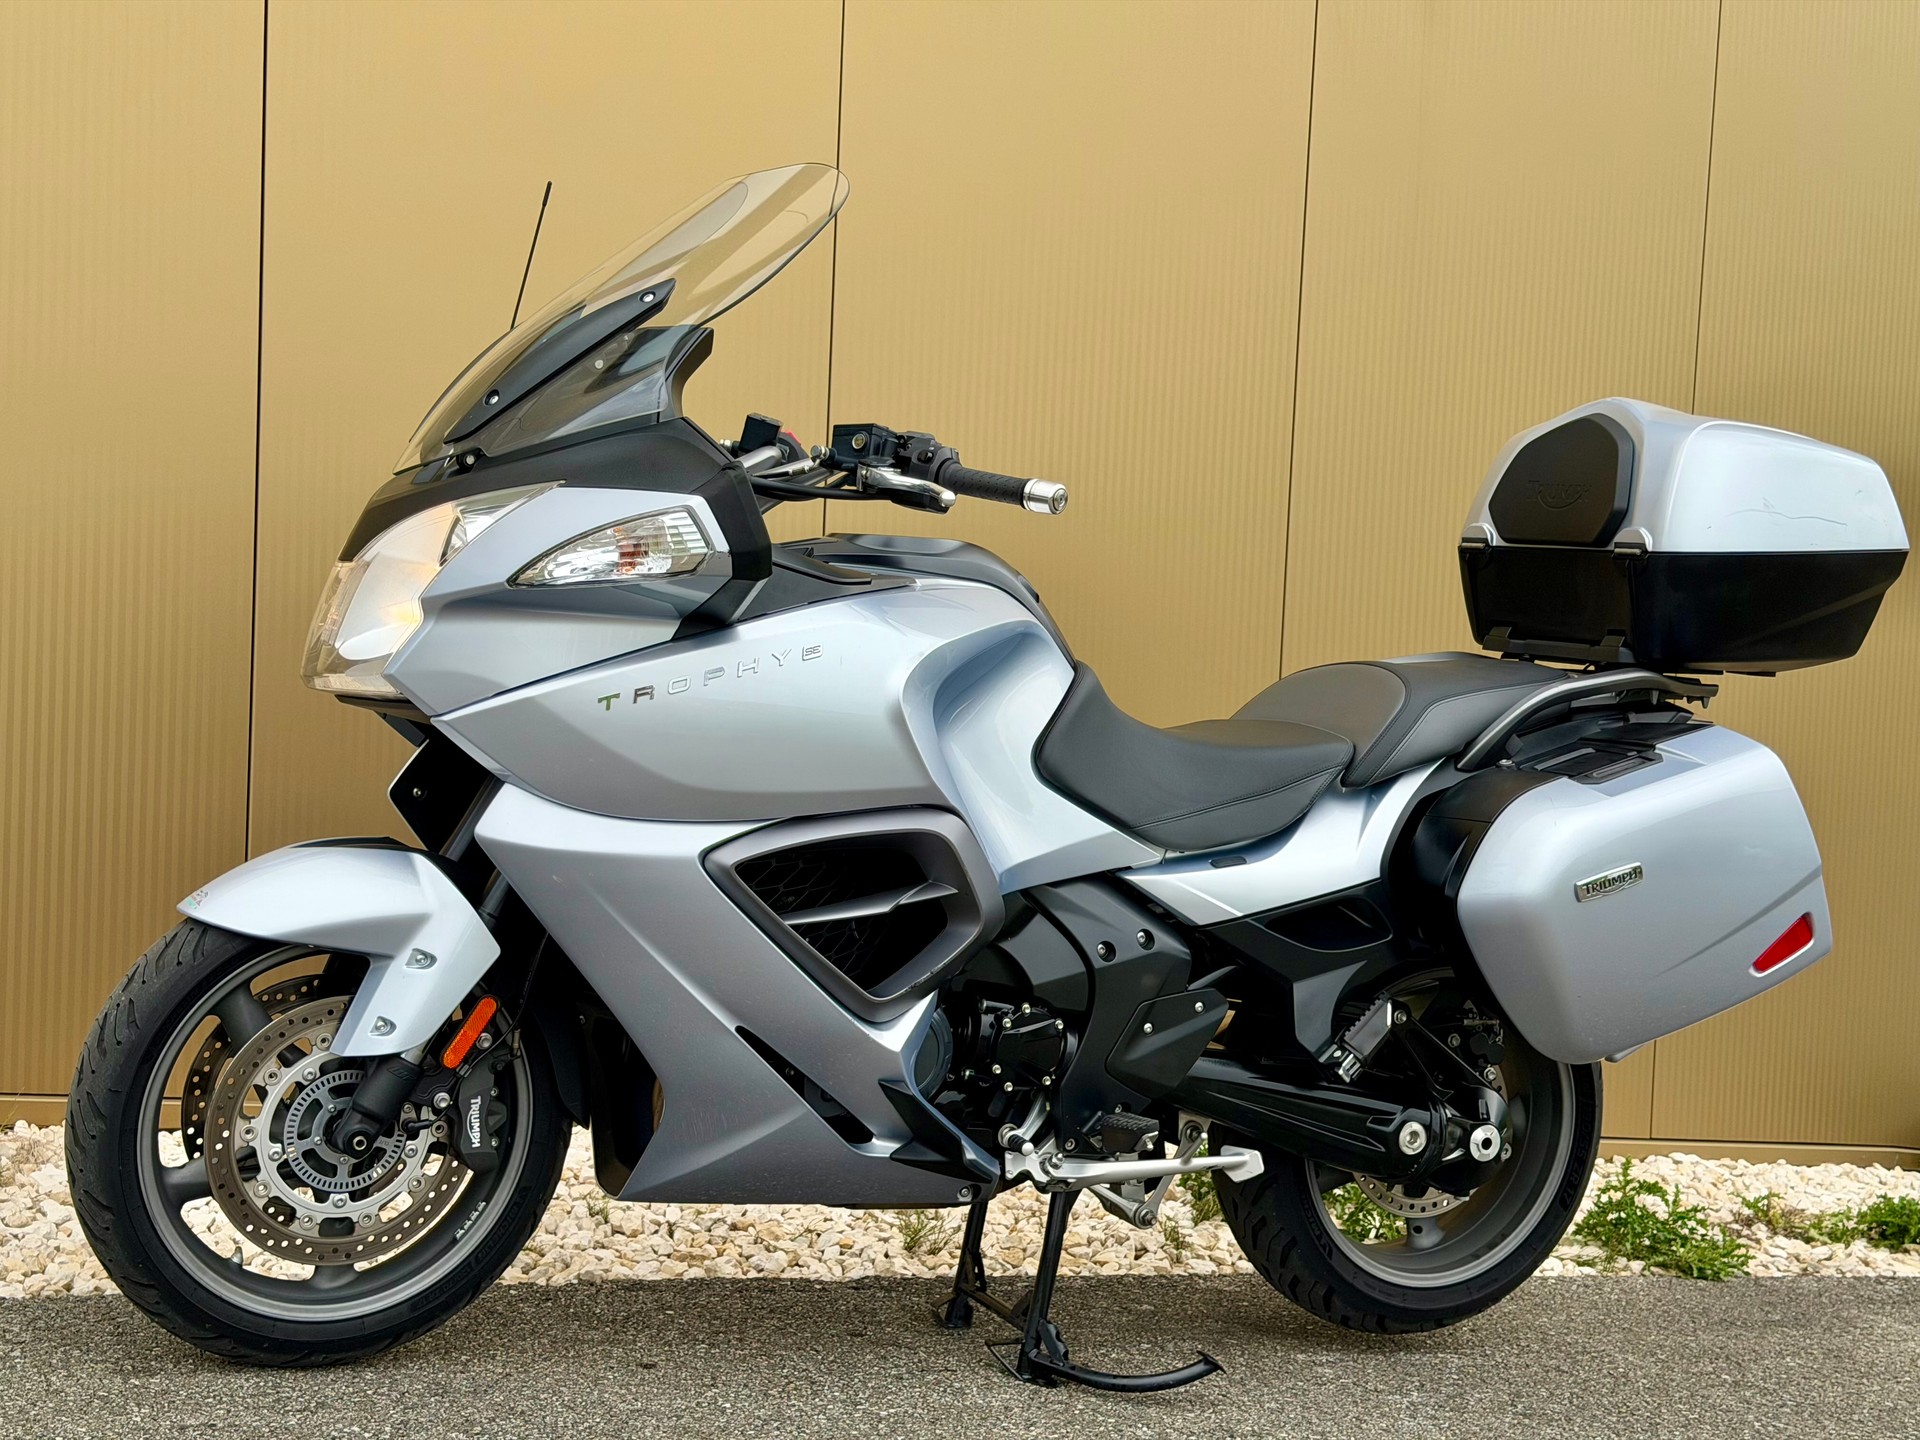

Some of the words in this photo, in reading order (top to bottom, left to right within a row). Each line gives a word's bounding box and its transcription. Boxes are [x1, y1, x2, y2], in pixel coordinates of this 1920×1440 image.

[597, 647, 793, 711] TROPHY
[803, 644, 823, 658] SE
[1581, 866, 1638, 895] TRIUMPH
[470, 1095, 481, 1148] TRIUMPH
